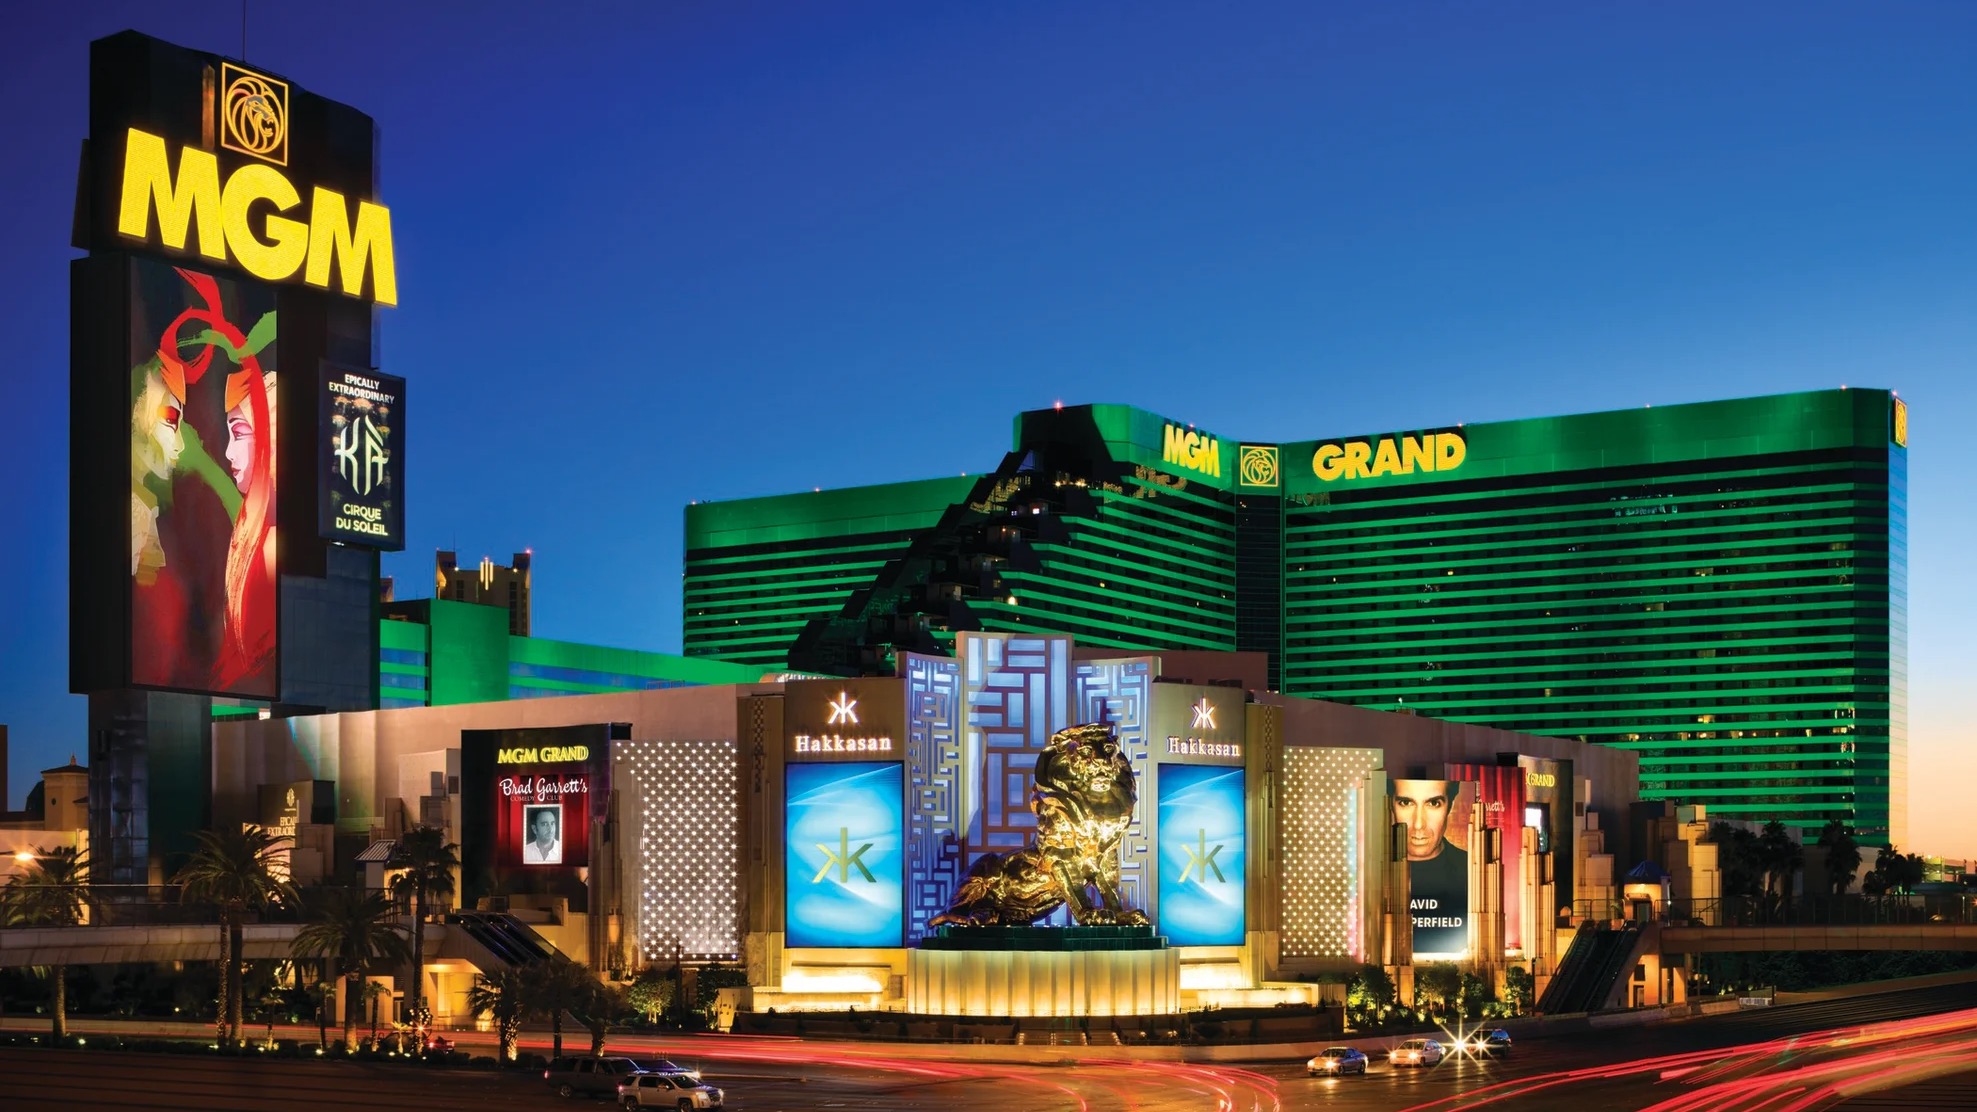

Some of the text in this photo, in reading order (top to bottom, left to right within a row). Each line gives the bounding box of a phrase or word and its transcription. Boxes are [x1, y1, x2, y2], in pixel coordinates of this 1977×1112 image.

[118, 127, 398, 306] MGM
[344, 373, 380, 390] EPICALLY
[328, 381, 395, 404] EXTRAORDINARY
[1163, 423, 1220, 478] MGM
[1312, 432, 1466, 482] GRAND
[343, 503, 381, 522] CIRQUE
[335, 517, 388, 536] DU SOLEIL
[795, 735, 892, 752] Hakkasan
[1168, 736, 1240, 757] Hakkasan
[497, 745, 589, 764] MGM GRAND
[499, 778, 588, 801] Brad Garrett's
[1409, 899, 1438, 910] AVID
[1411, 917, 1463, 928] PERFIELD
